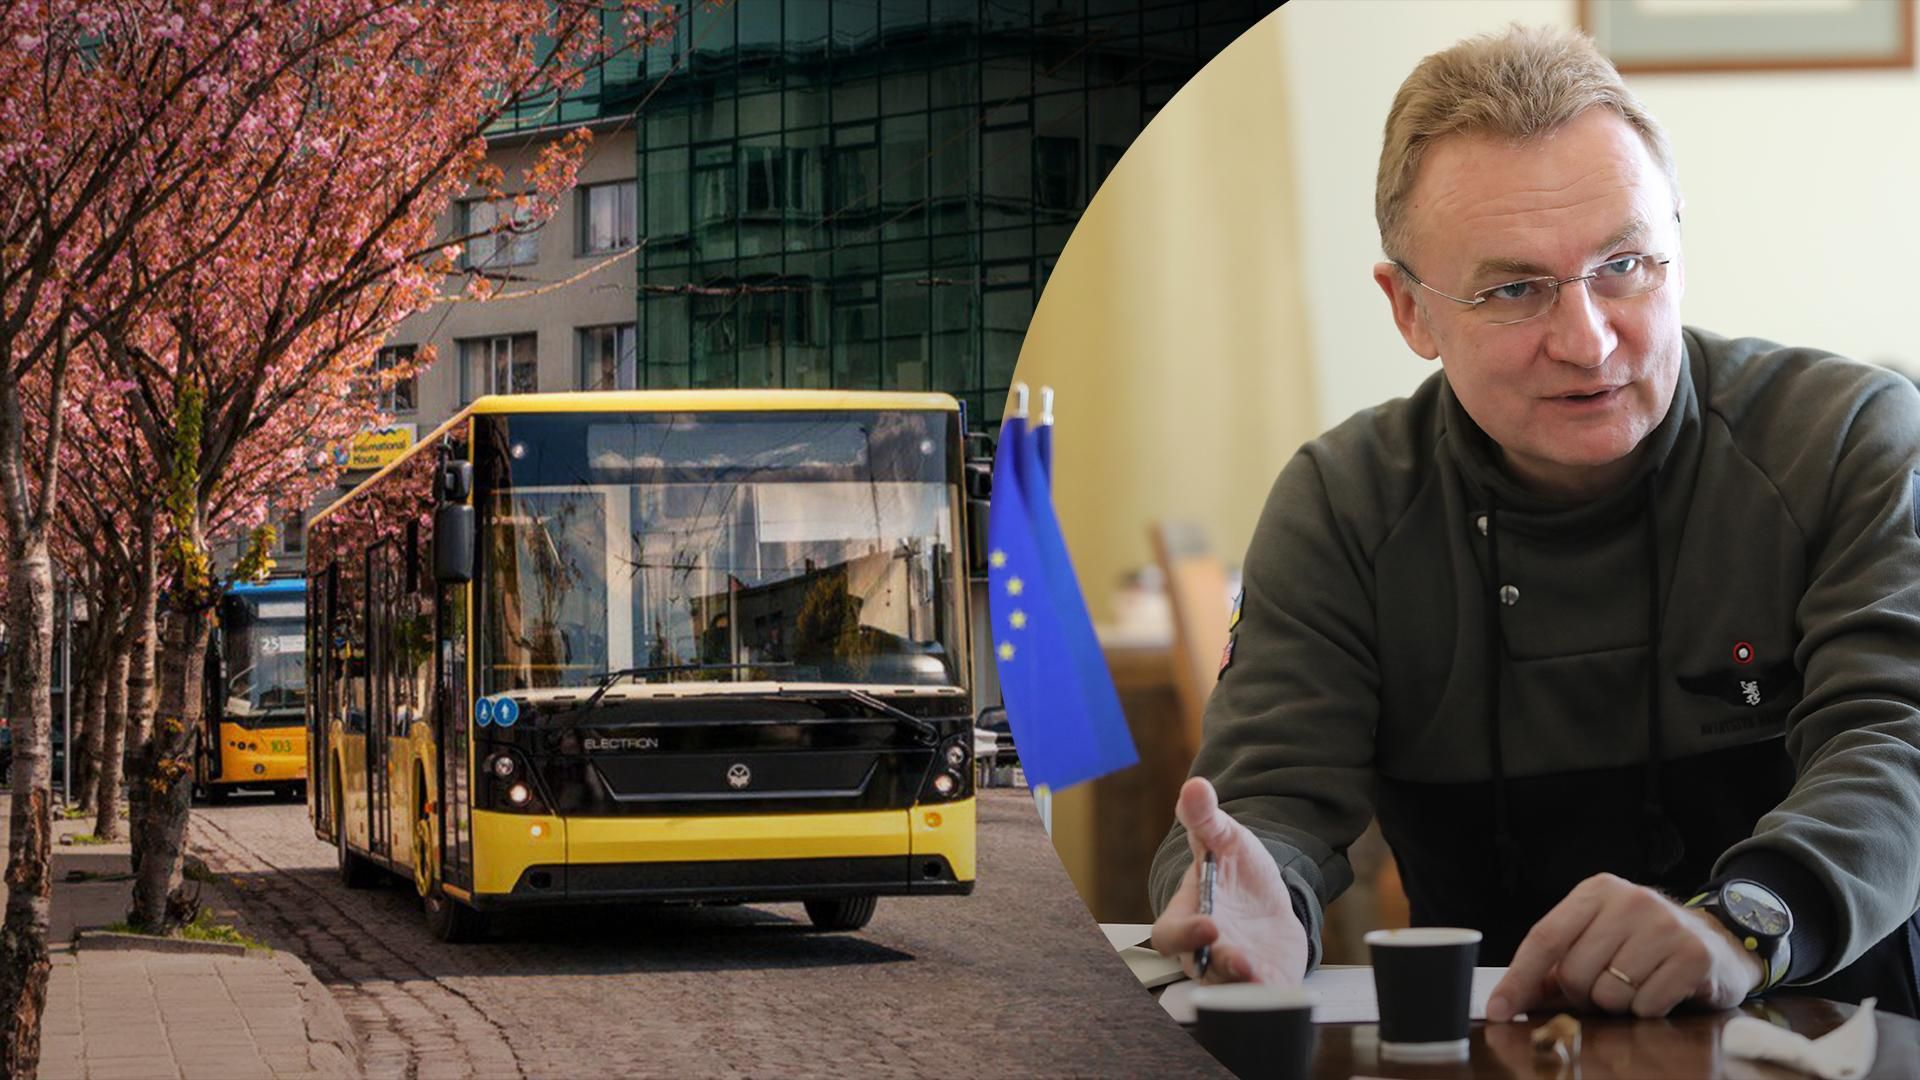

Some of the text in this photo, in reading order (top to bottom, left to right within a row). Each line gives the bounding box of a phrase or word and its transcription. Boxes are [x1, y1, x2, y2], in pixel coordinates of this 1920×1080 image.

[262, 638, 279, 650] 25
[271, 739, 292, 753] 103
[583, 737, 659, 750] ELECTRON
